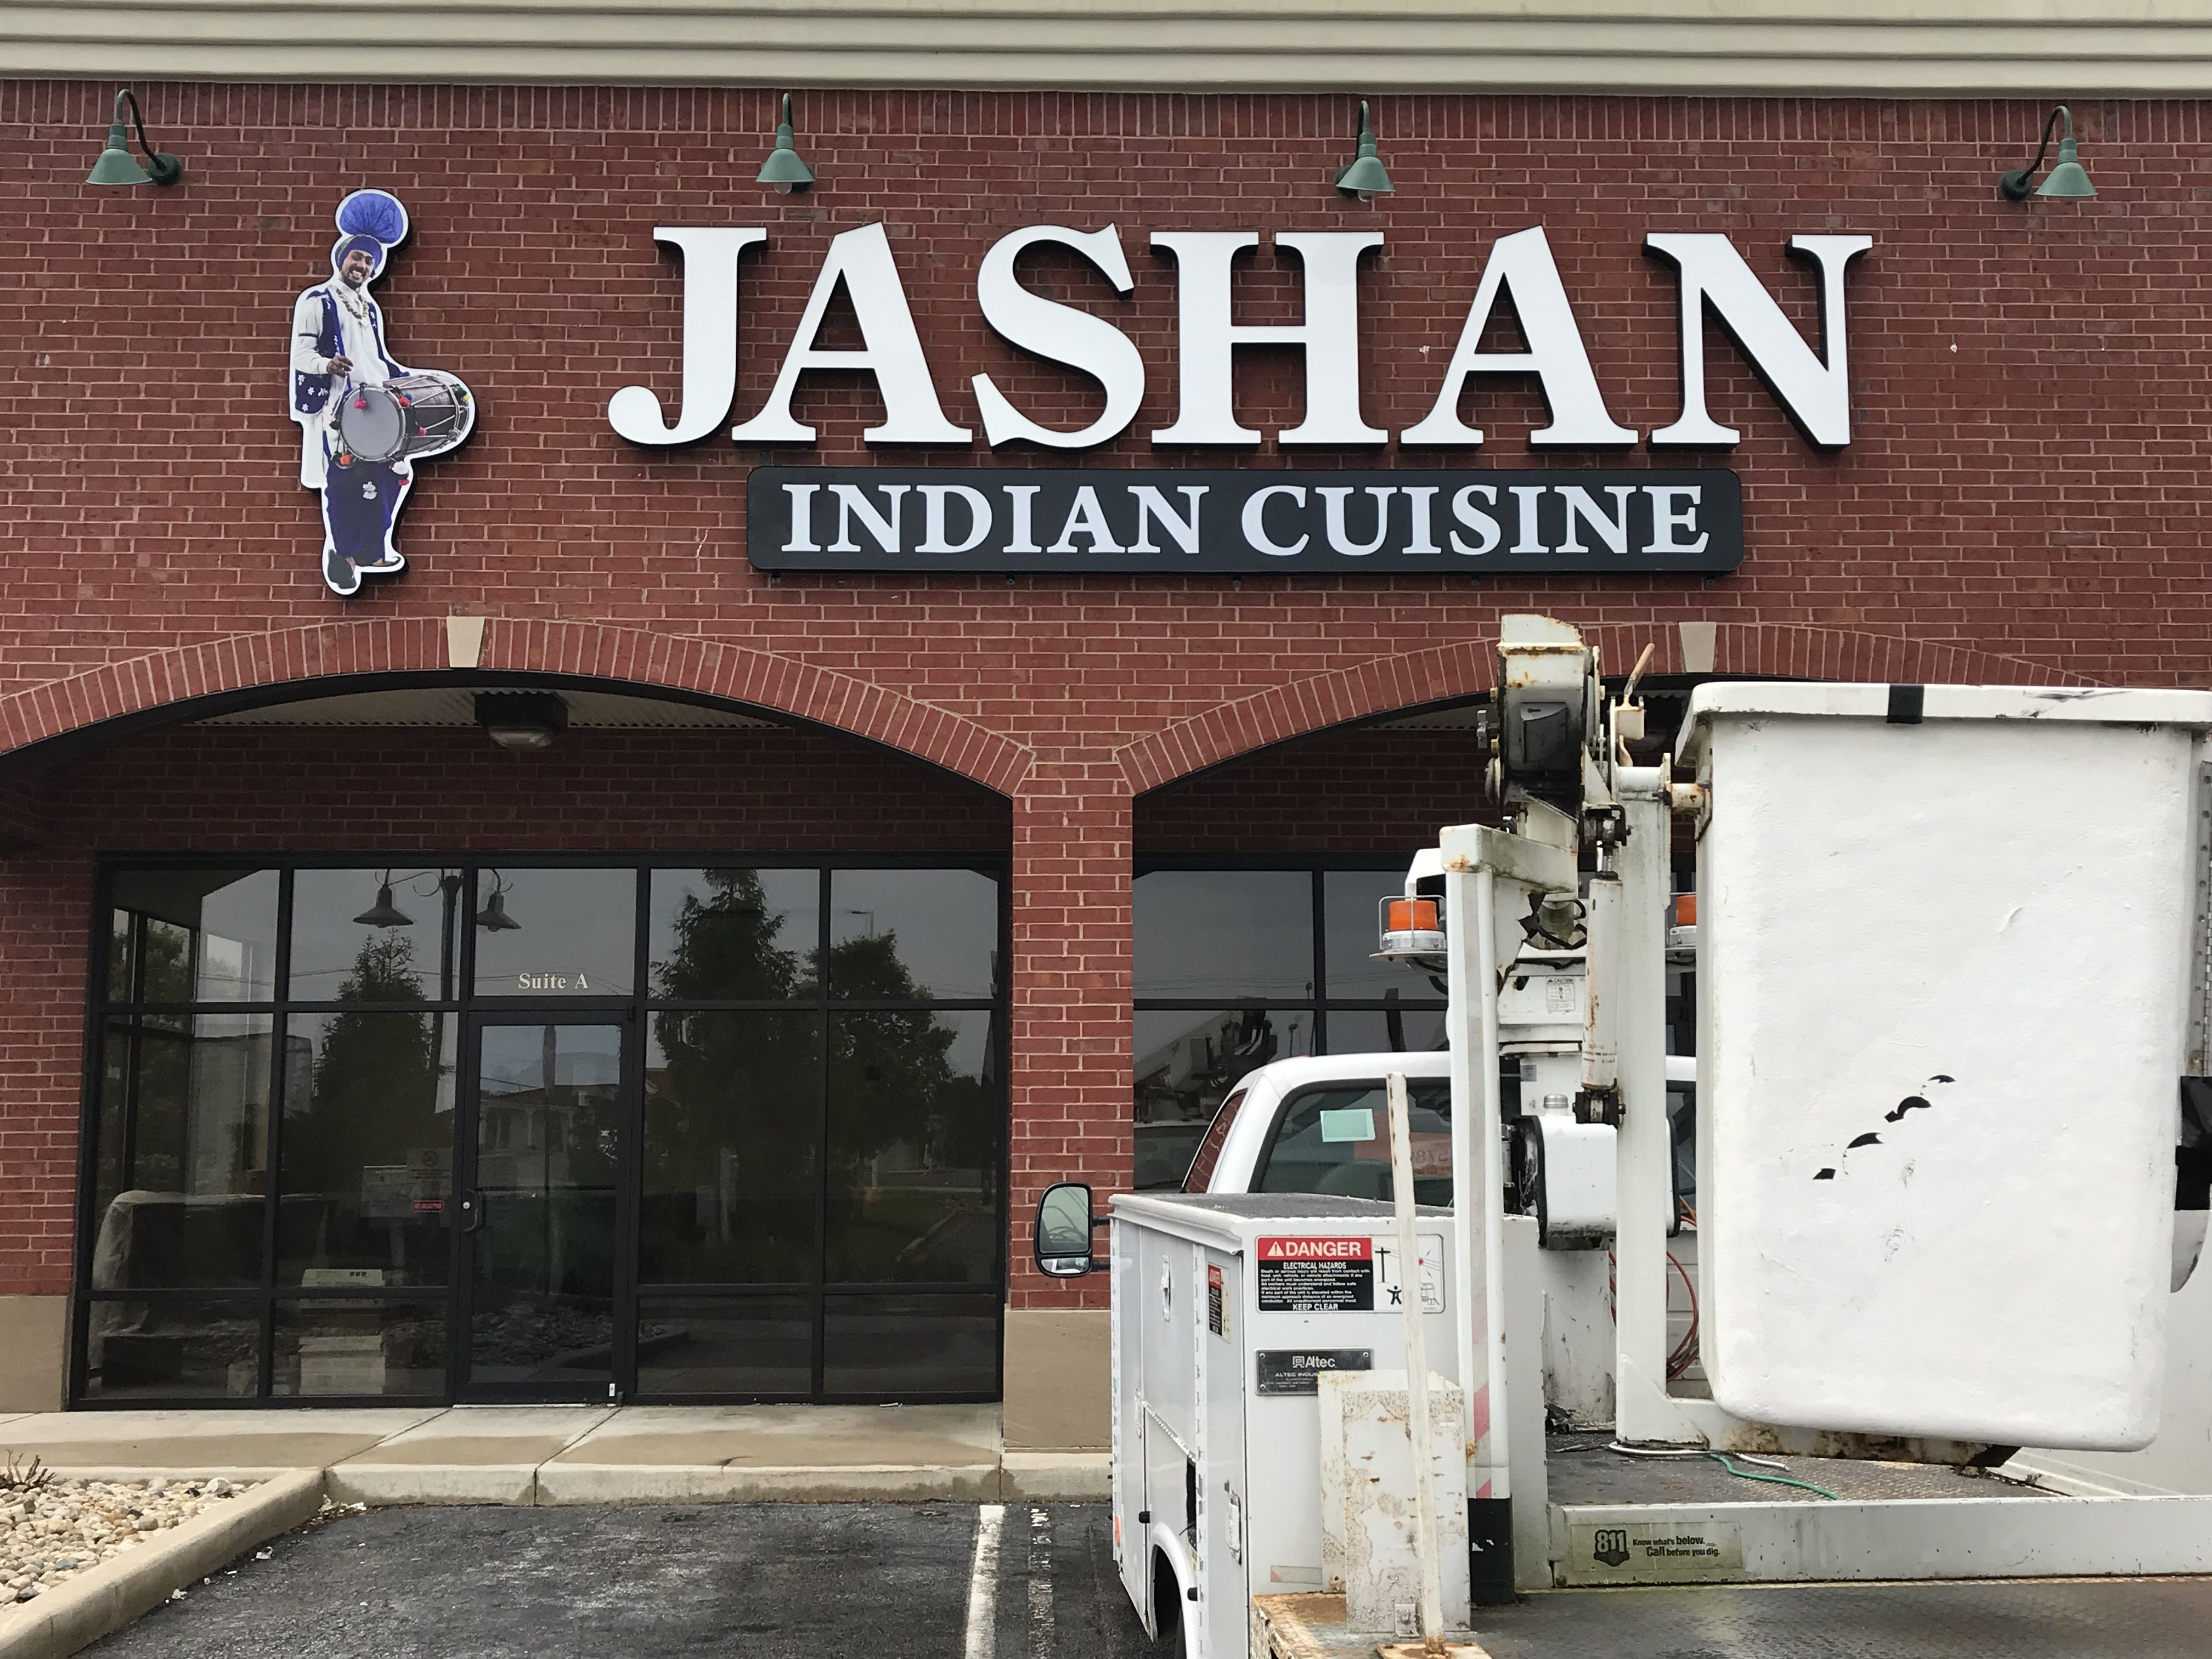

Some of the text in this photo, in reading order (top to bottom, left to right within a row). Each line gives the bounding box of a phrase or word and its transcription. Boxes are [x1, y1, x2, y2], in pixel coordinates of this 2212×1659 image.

[607, 222, 1872, 448] JASHAN
[781, 484, 1709, 555] INDIAN CUISINE
[518, 973, 589, 989] Suite A
[1285, 1242, 1361, 1256] DANGER
[1305, 1356, 1335, 1368] Altec
[1595, 1530, 1627, 1553] 811
[1676, 1536, 1706, 1545] below.
[1646, 1547, 1665, 1556] Call
[1666, 1548, 1691, 1556] before
[1706, 1548, 1720, 1556] dig.
